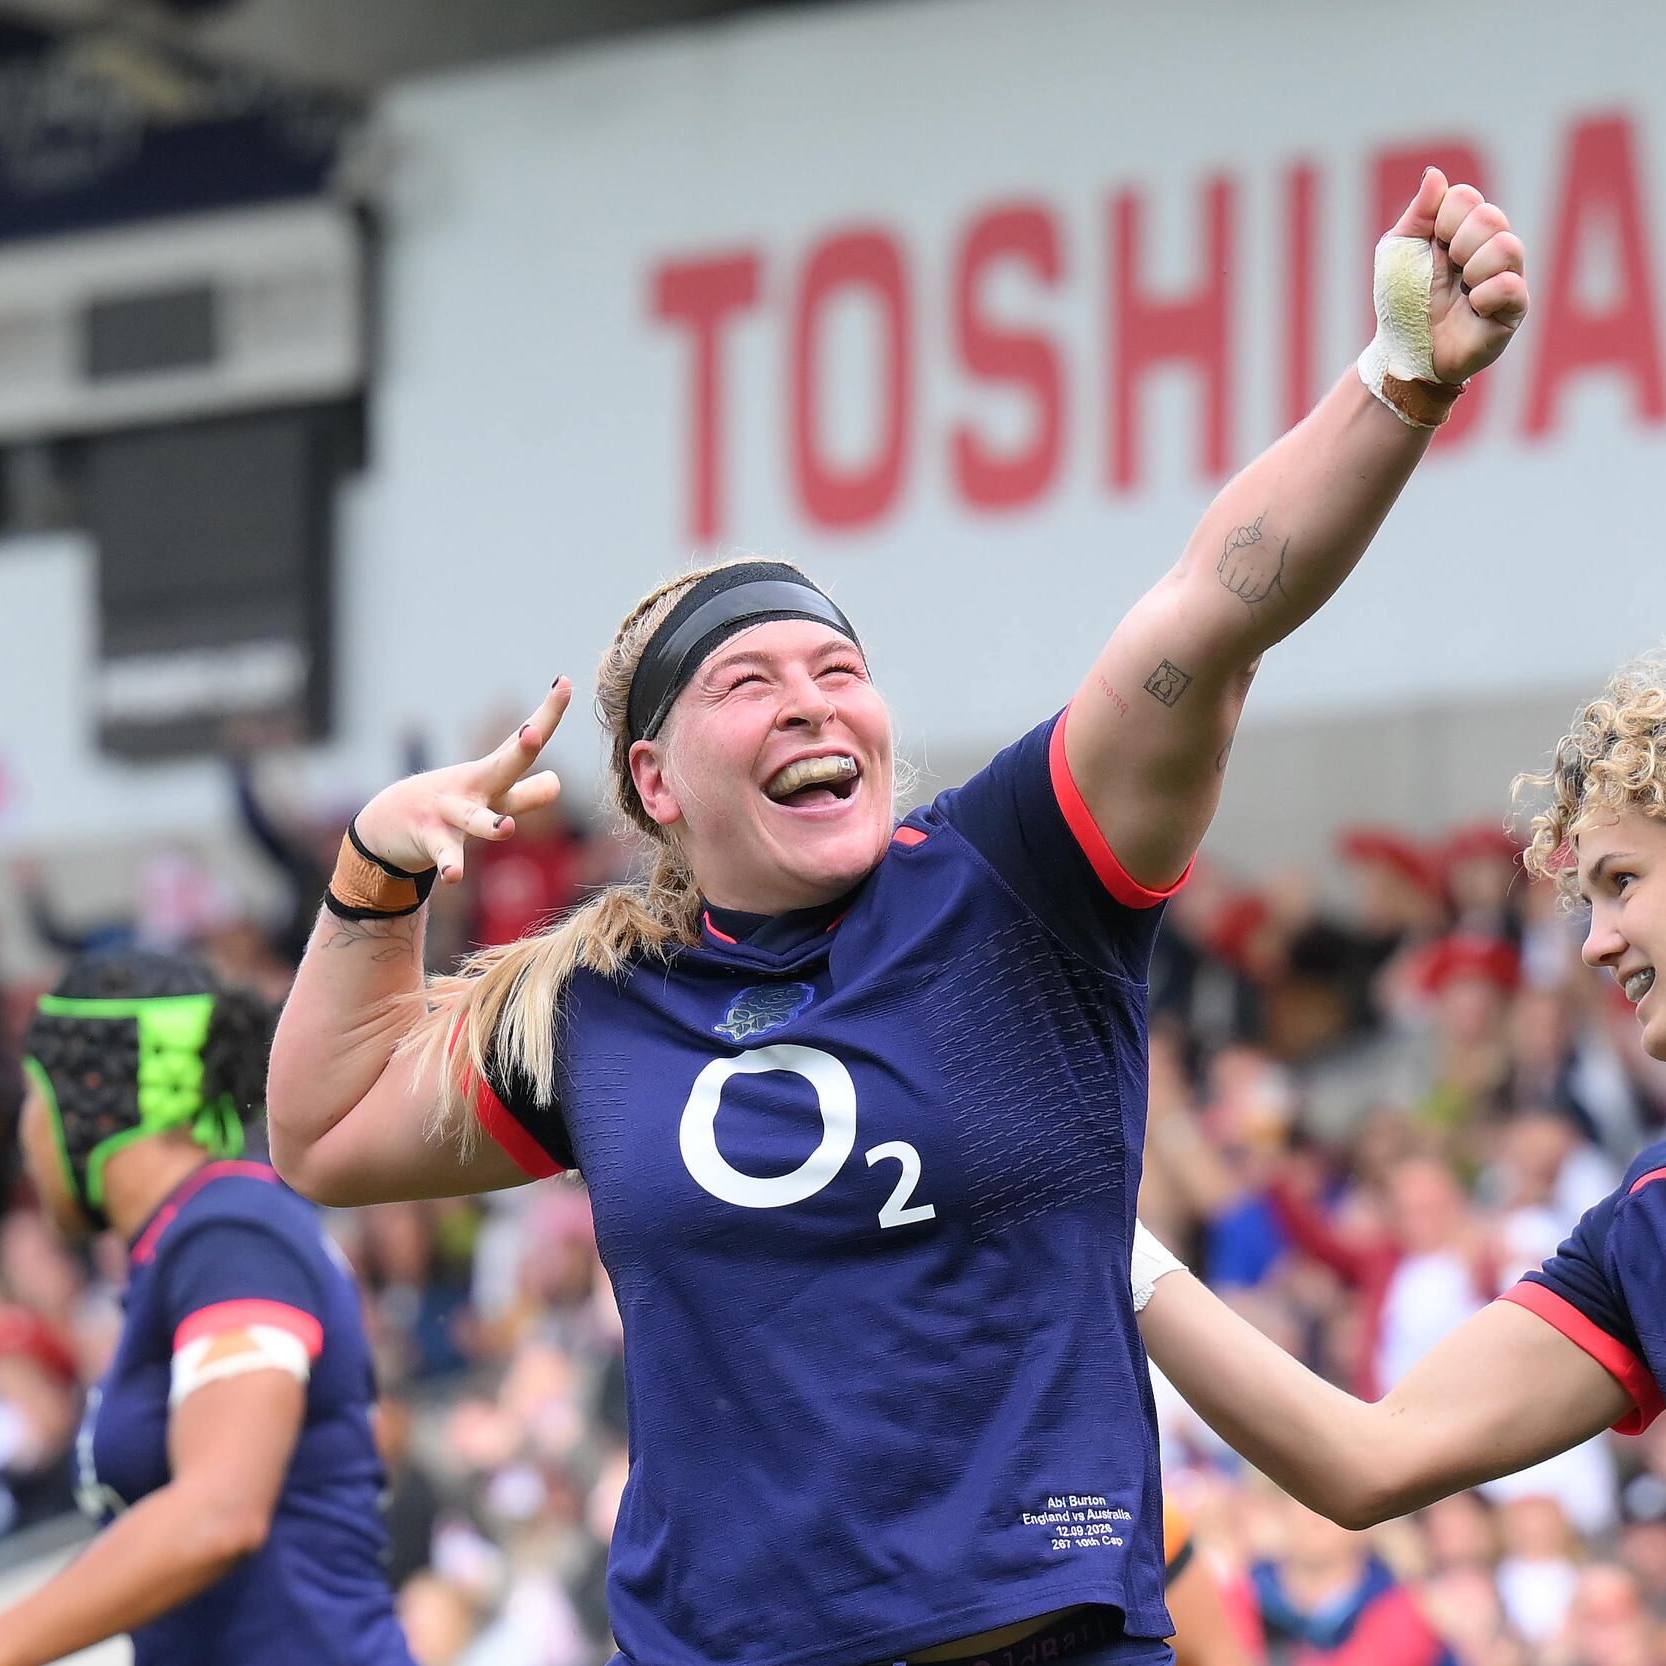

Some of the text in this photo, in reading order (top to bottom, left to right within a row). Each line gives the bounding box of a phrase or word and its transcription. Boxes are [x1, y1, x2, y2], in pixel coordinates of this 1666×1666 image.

[1047, 1495, 1107, 1509] Abi Burton
[1022, 1508, 1132, 1526] England vs Australia
[1101, 1535, 1123, 1547] Cap
